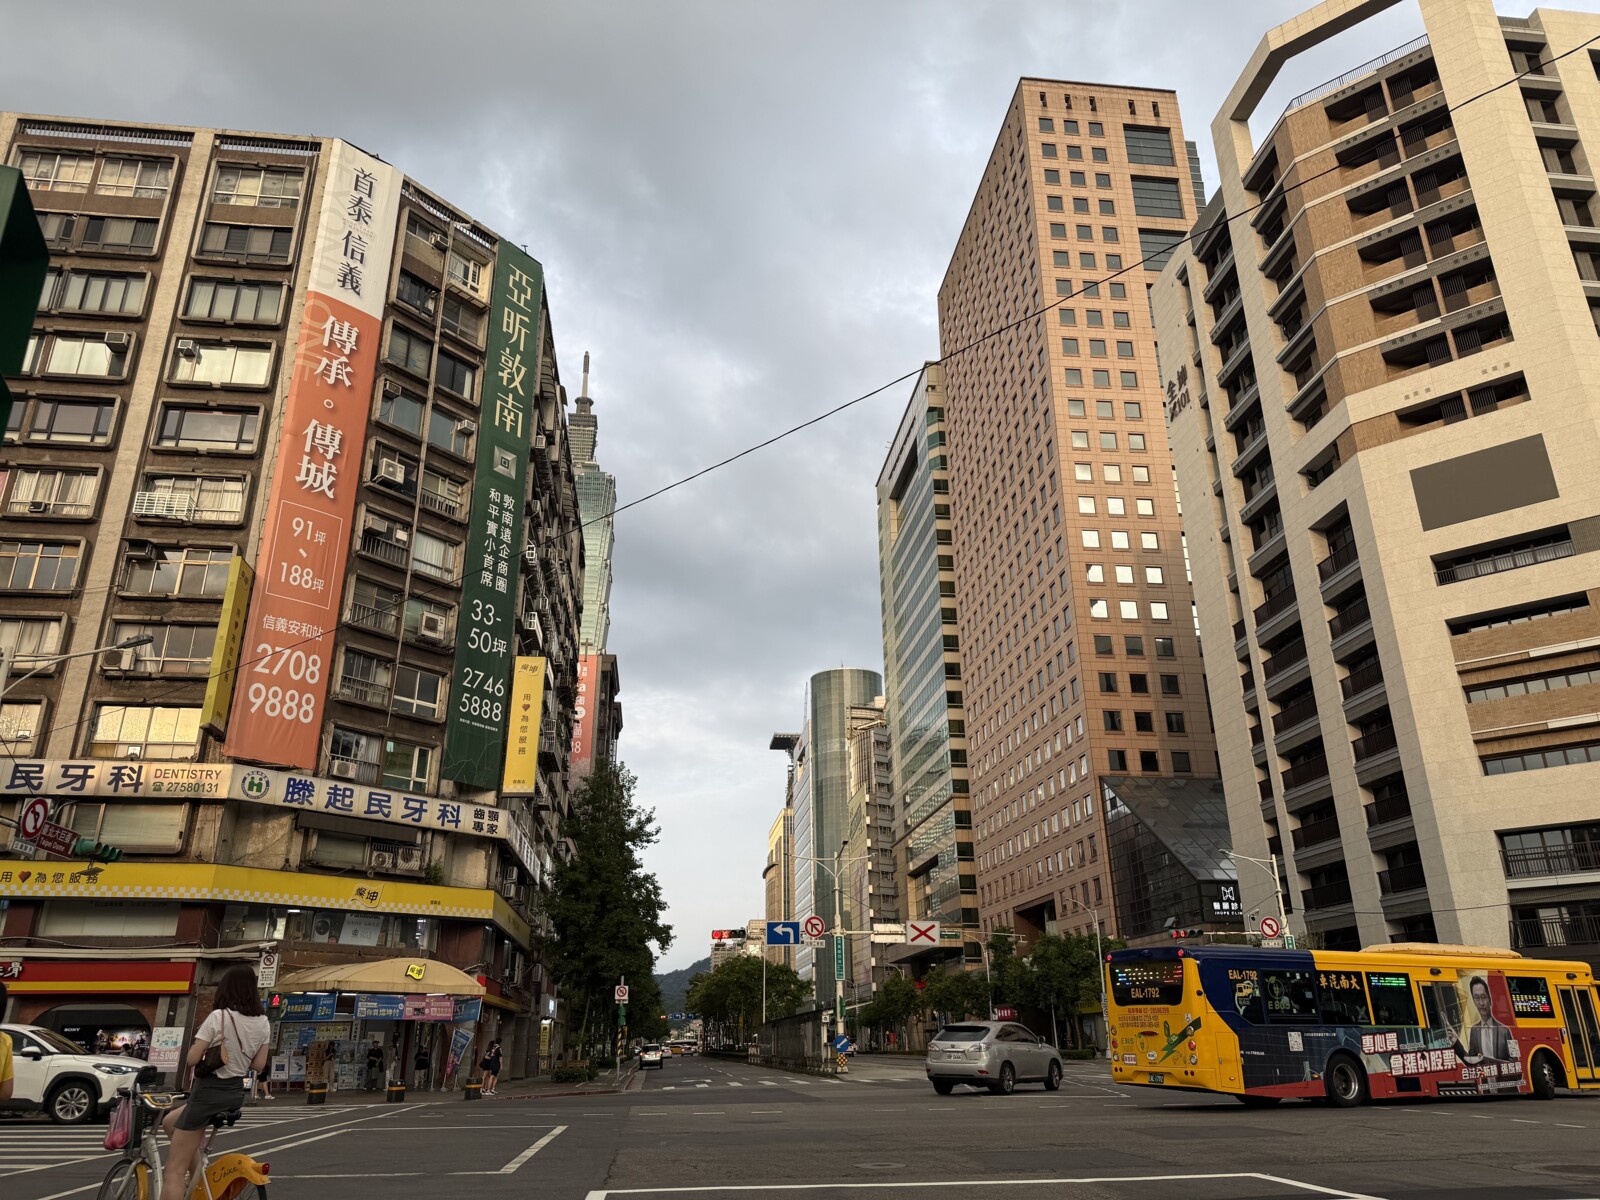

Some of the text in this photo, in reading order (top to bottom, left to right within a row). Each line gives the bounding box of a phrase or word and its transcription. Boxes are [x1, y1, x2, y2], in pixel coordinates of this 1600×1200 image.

[337, 167, 378, 297] 首泰信義
[494, 263, 534, 438] 亞昕敦南
[481, 488, 501, 587] 和平實小首席
[495, 494, 515, 593] 敦南遠企商圈
[262, 614, 323, 641] 信義安和站
[467, 627, 507, 658] 50坪
[253, 643, 321, 684] 2708
[462, 667, 504, 697] 2746
[248, 683, 315, 724] 9888
[459, 693, 502, 722] 5888
[5, 763, 144, 794] 民牙科
[154, 768, 222, 780] DENTISTRY
[166, 781, 219, 793] 27580131
[1228, 969, 1258, 980] EAL-1792
[1130, 988, 1160, 999] EAL-1792
[1361, 1032, 1398, 1054] 專心買
[1390, 1049, 1456, 1076] 會漲的股票
